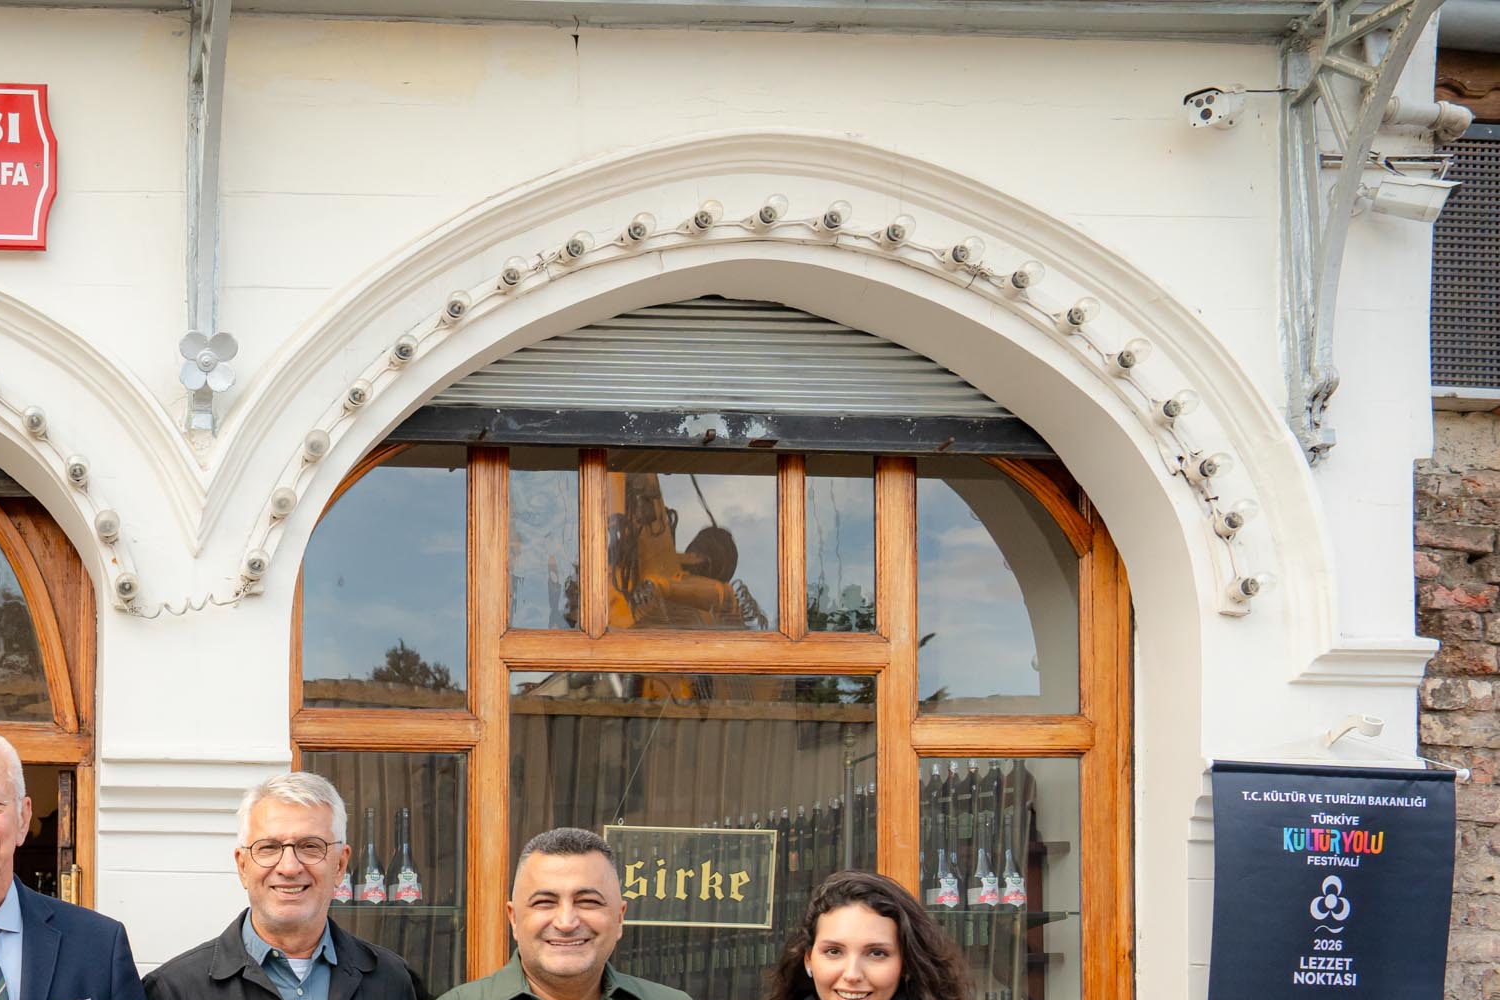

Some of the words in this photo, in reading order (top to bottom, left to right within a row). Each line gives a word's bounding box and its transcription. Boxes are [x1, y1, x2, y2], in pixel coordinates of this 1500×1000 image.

[1242, 791, 1262, 801] T.C.
[1263, 790, 1306, 803] KÜLTÜR
[1308, 793, 1323, 803] VE
[1324, 793, 1367, 805] TURİZM
[1368, 796, 1427, 808] BAKANLIĞI
[1311, 812, 1360, 826] TÜRKİYE
[1307, 854, 1360, 867] FESTİVALİ
[622, 858, 750, 902] Sirke
[1313, 939, 1343, 951] 2026
[1300, 956, 1353, 970] LEZZET
[1293, 971, 1357, 986] NOKTASI
